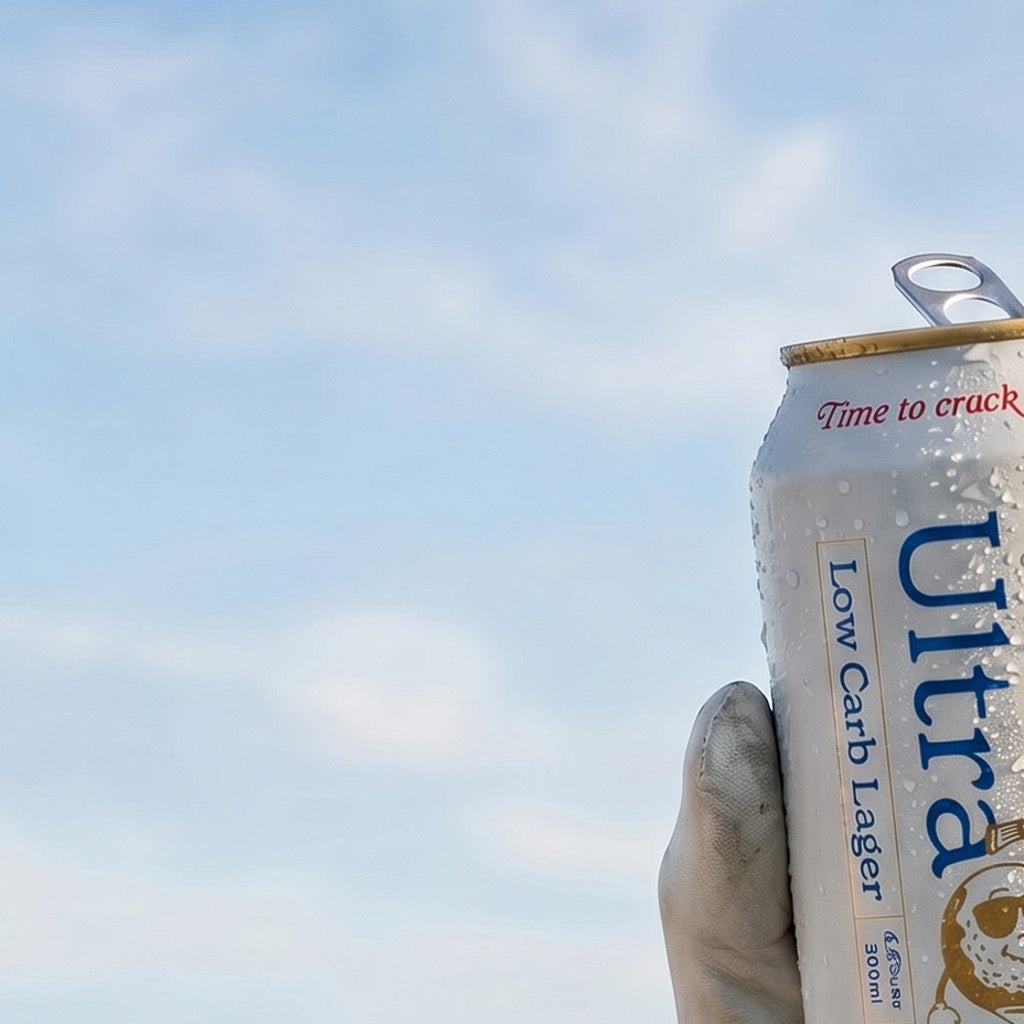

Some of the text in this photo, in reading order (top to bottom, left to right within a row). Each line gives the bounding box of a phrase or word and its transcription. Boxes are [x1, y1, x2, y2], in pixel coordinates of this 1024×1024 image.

[817, 401, 889, 430] Time
[897, 397, 926, 422] to
[829, 559, 883, 902] Low Carb Lager
[897, 511, 1009, 879] Ultra
[864, 943, 883, 1004] 300ml
